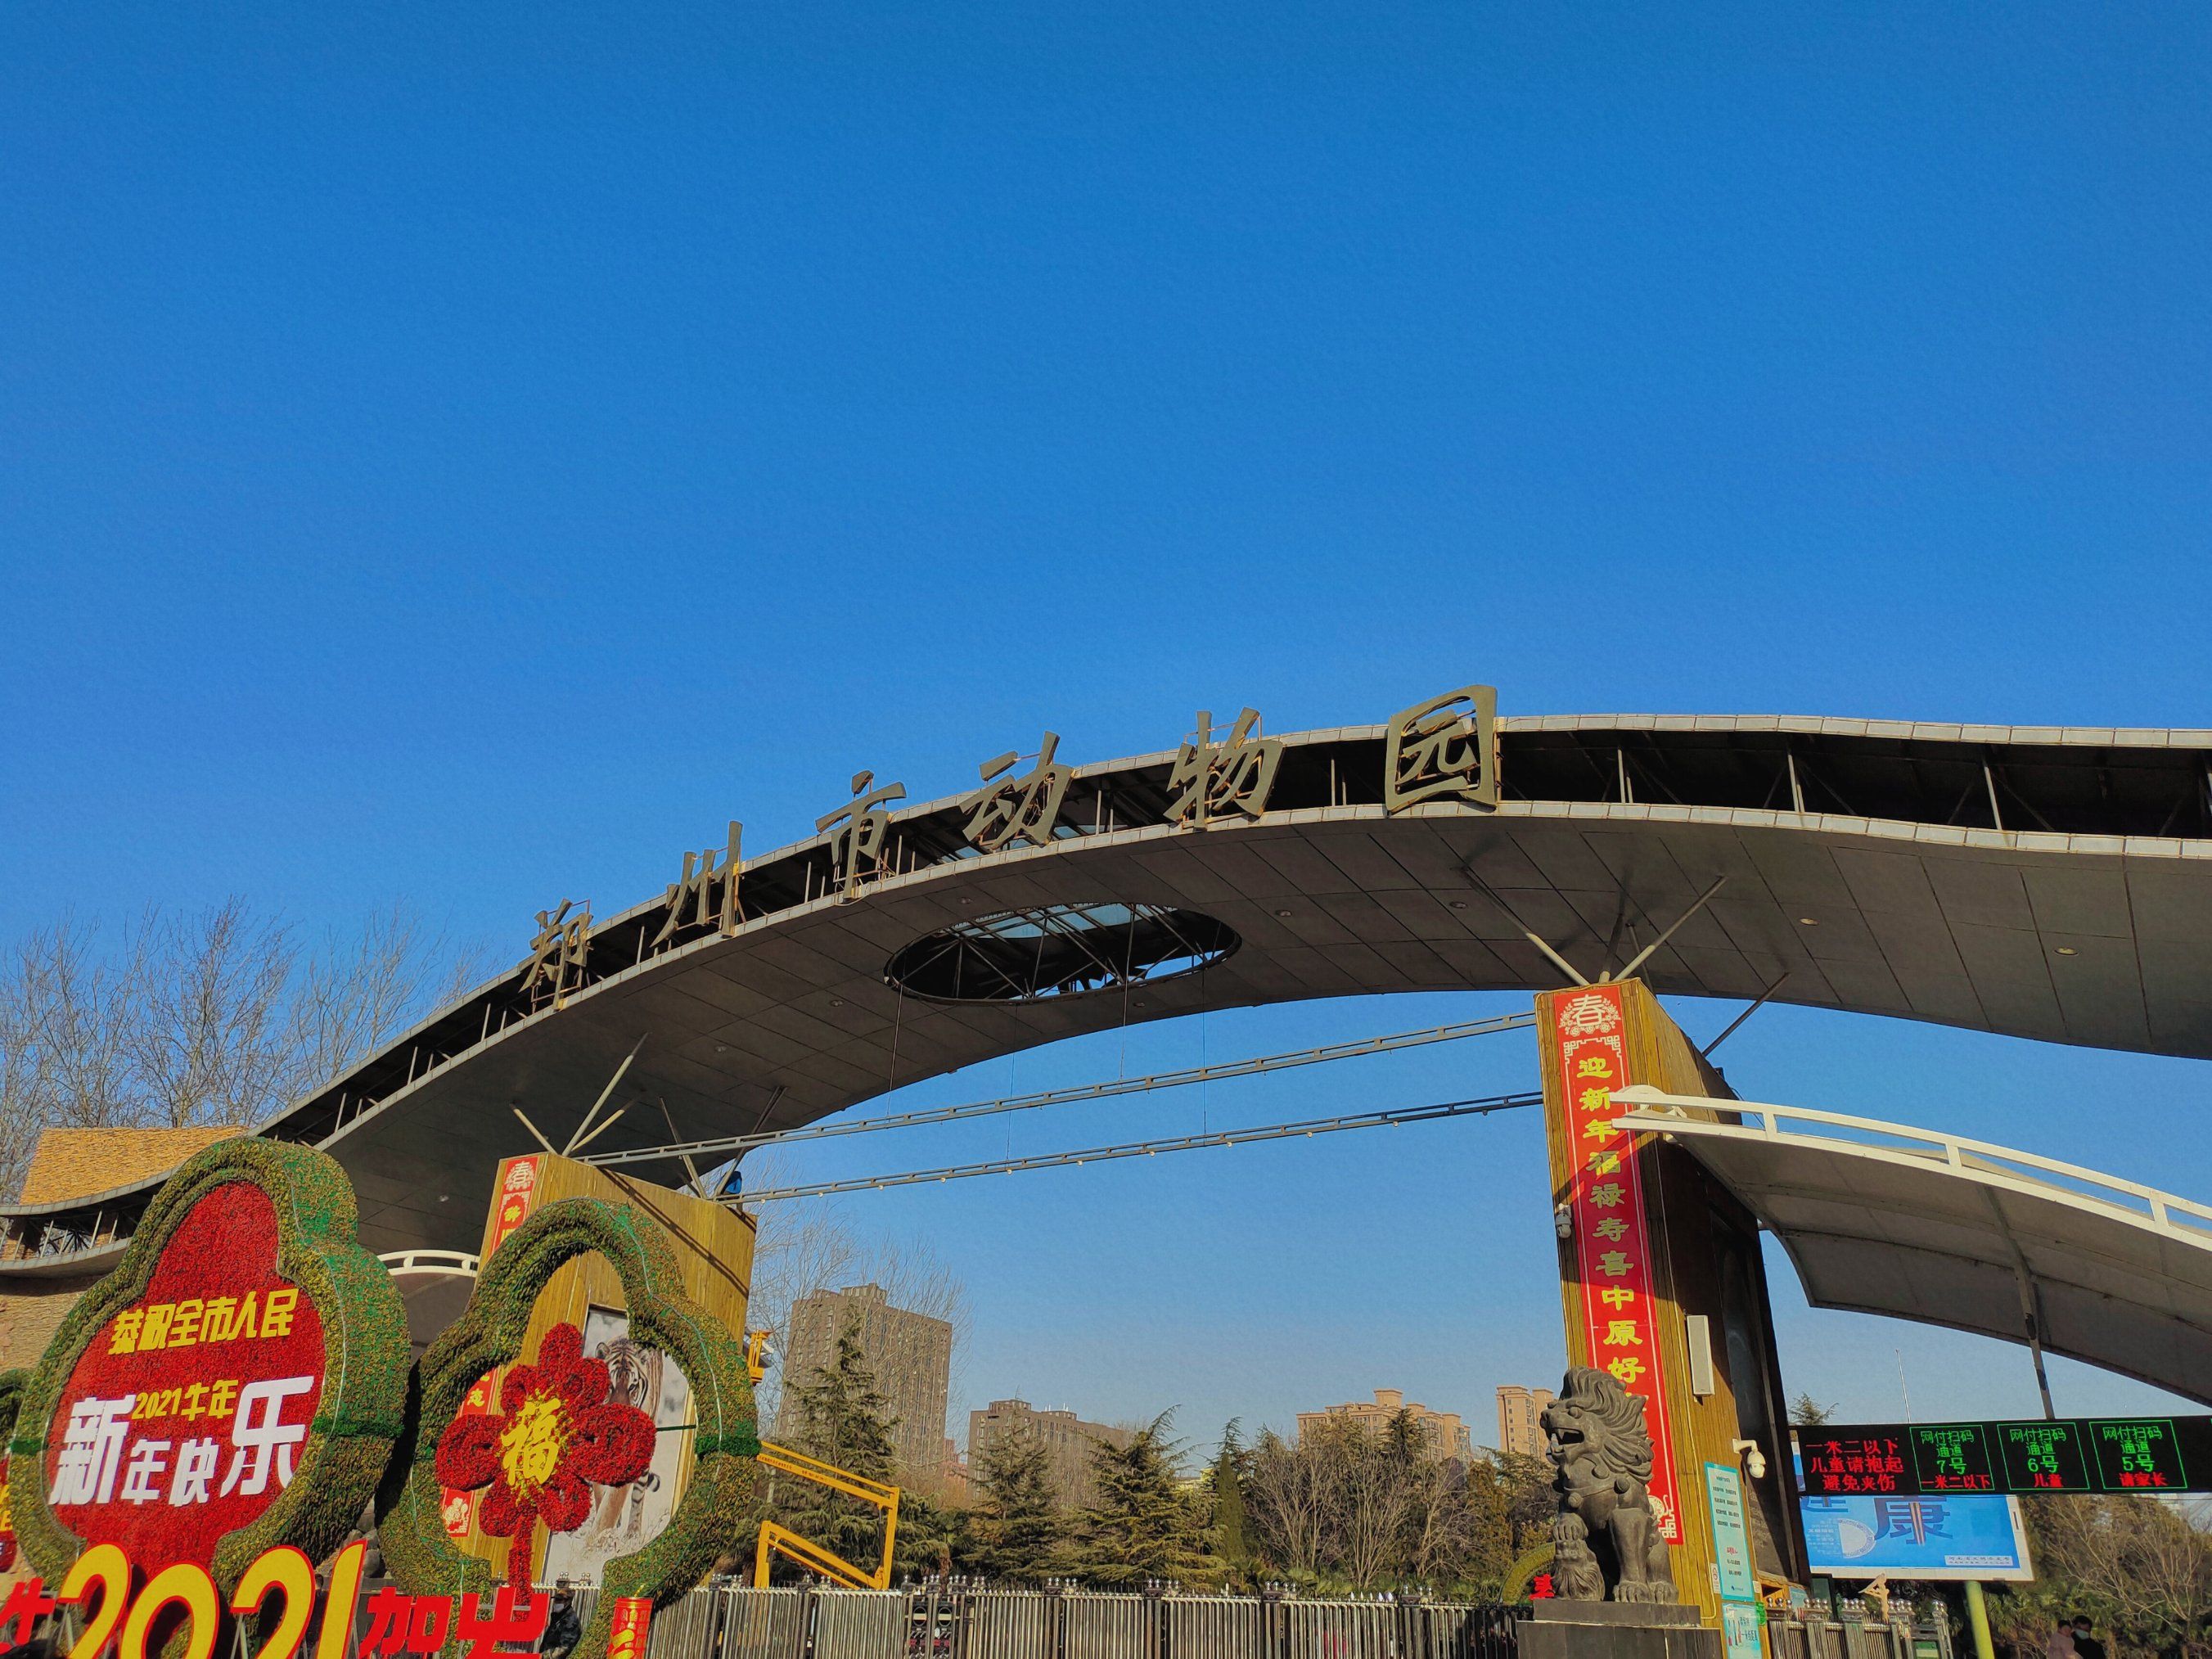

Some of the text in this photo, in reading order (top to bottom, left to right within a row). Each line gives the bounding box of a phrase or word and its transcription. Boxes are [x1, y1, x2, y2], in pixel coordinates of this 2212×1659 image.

[518, 684, 1498, 1011] 郑州市动物园
[1570, 994, 1606, 1027] 春
[1576, 1057, 1647, 1398] 迎新年福禄寿喜中原好
[48, 1376, 314, 1508] 新年快乐
[500, 1395, 561, 1486] 福
[1920, 1429, 1975, 1444] 网付扫码
[2010, 1427, 2066, 1442] 网付扫码
[2102, 1426, 2163, 1440] 网付扫码
[1805, 1437, 1899, 1455] 一米二以下
[1936, 1443, 1964, 1458] 通道
[2026, 1441, 2057, 1456] 通道
[2120, 1440, 2151, 1454] 通道
[1810, 1455, 1904, 1474] 儿童请抱起
[1936, 1457, 1966, 1475] 7号
[2027, 1455, 2059, 1472] 6号
[2122, 1454, 2155, 1472] 5号
[1822, 1474, 1896, 1493] 避免夹伤
[1921, 1474, 1991, 1490] 一米二以下
[2034, 1472, 2064, 1487] 儿童
[2119, 1472, 2169, 1487] 请家长
[56, 1540, 367, 1659] 2021
